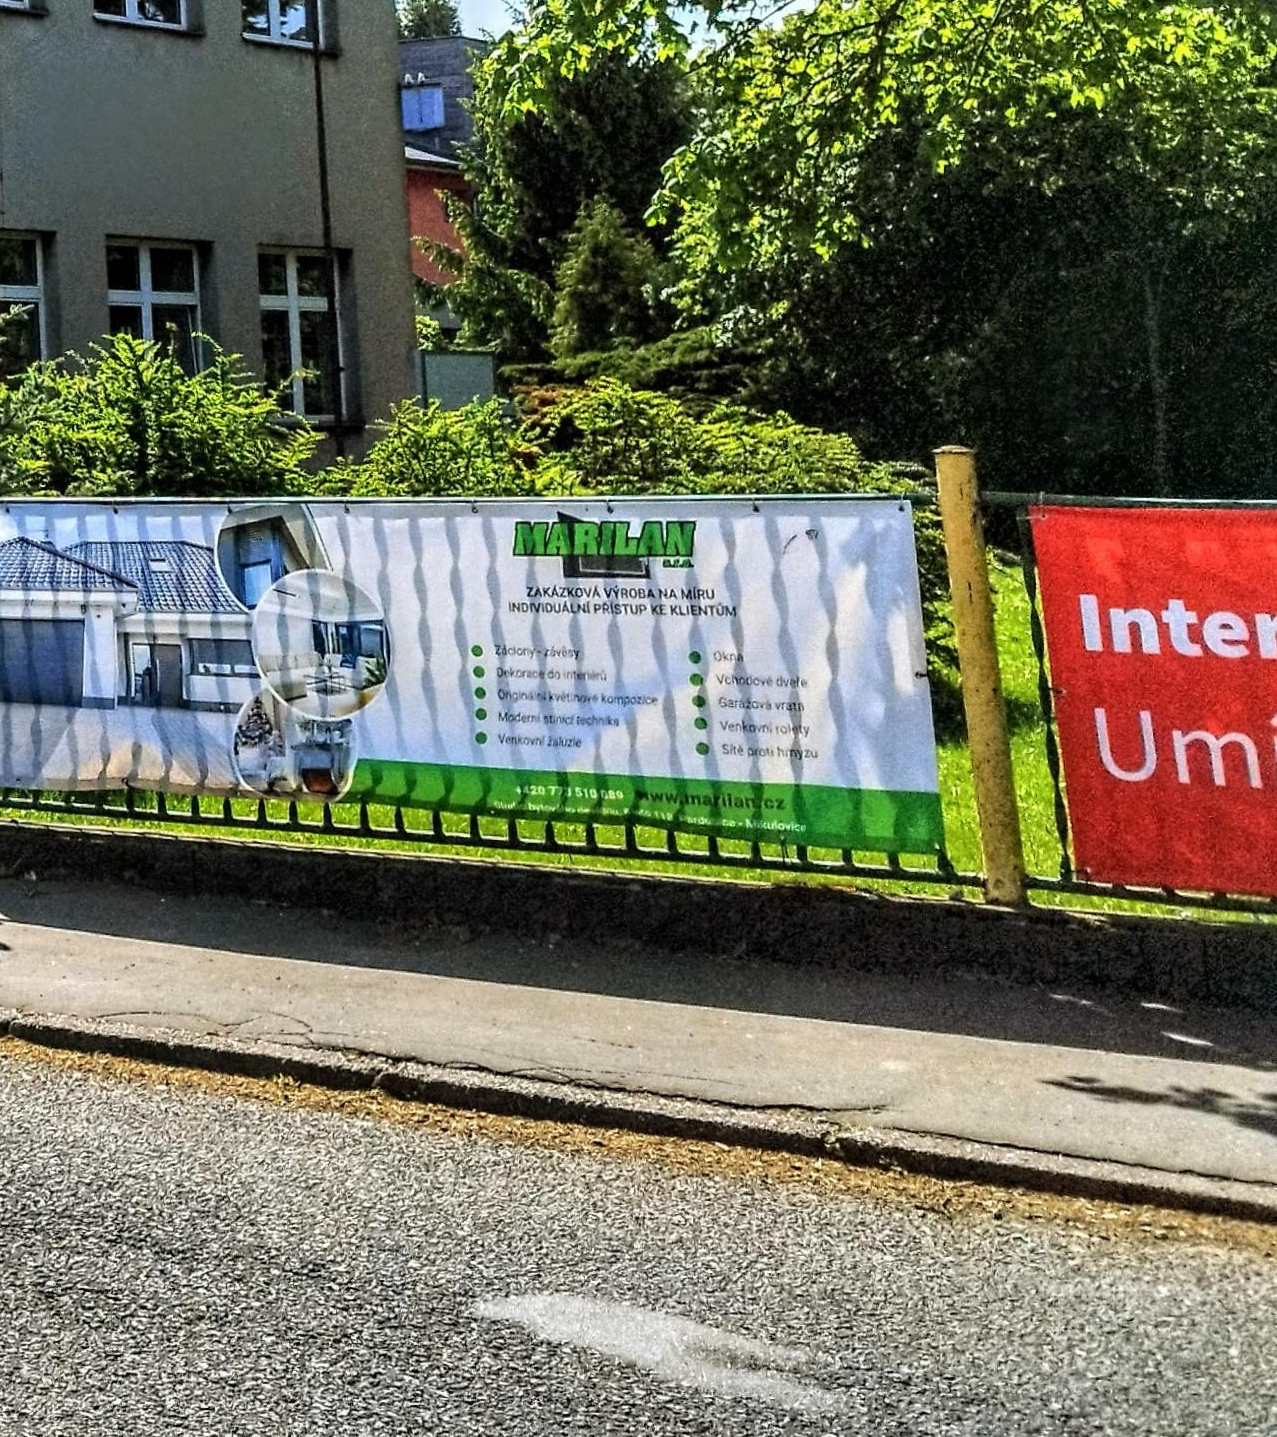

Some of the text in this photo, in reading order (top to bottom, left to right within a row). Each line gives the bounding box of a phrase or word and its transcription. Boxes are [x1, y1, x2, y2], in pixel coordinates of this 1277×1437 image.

[512, 520, 697, 556] MARILAN
[526, 585, 716, 600] ZAKÁZKOVÁ VÝROBA NA MÍRU
[508, 600, 738, 618] INDIVIDUÁLNÍ PŘÍSTUP KE KLIENTŮM
[713, 651, 744, 663] Okna
[548, 668, 561, 680] do
[1094, 706, 1277, 790] Um
[637, 790, 786, 811] ww.marilan.cz
